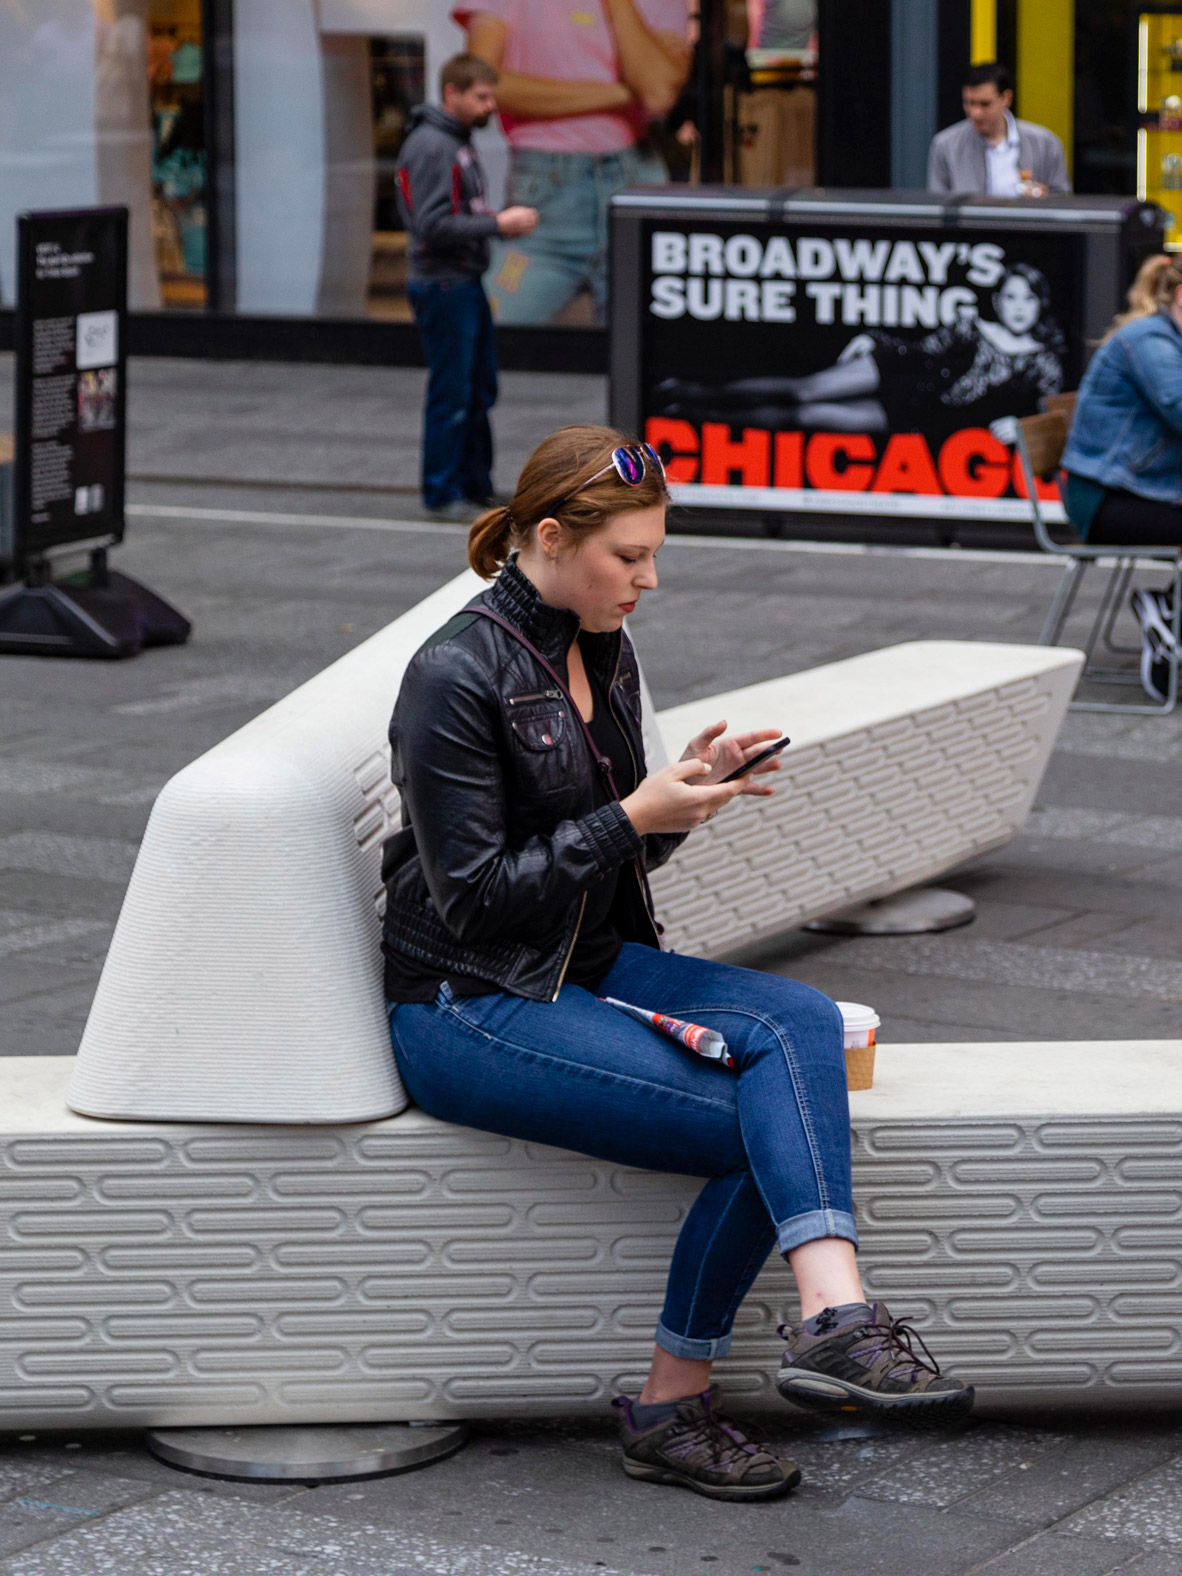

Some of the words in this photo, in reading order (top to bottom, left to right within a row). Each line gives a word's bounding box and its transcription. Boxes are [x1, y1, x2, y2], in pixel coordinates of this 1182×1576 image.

[651, 231, 1005, 287] BROADWAY'S
[649, 275, 797, 323] SURE
[806, 282, 978, 328] THING
